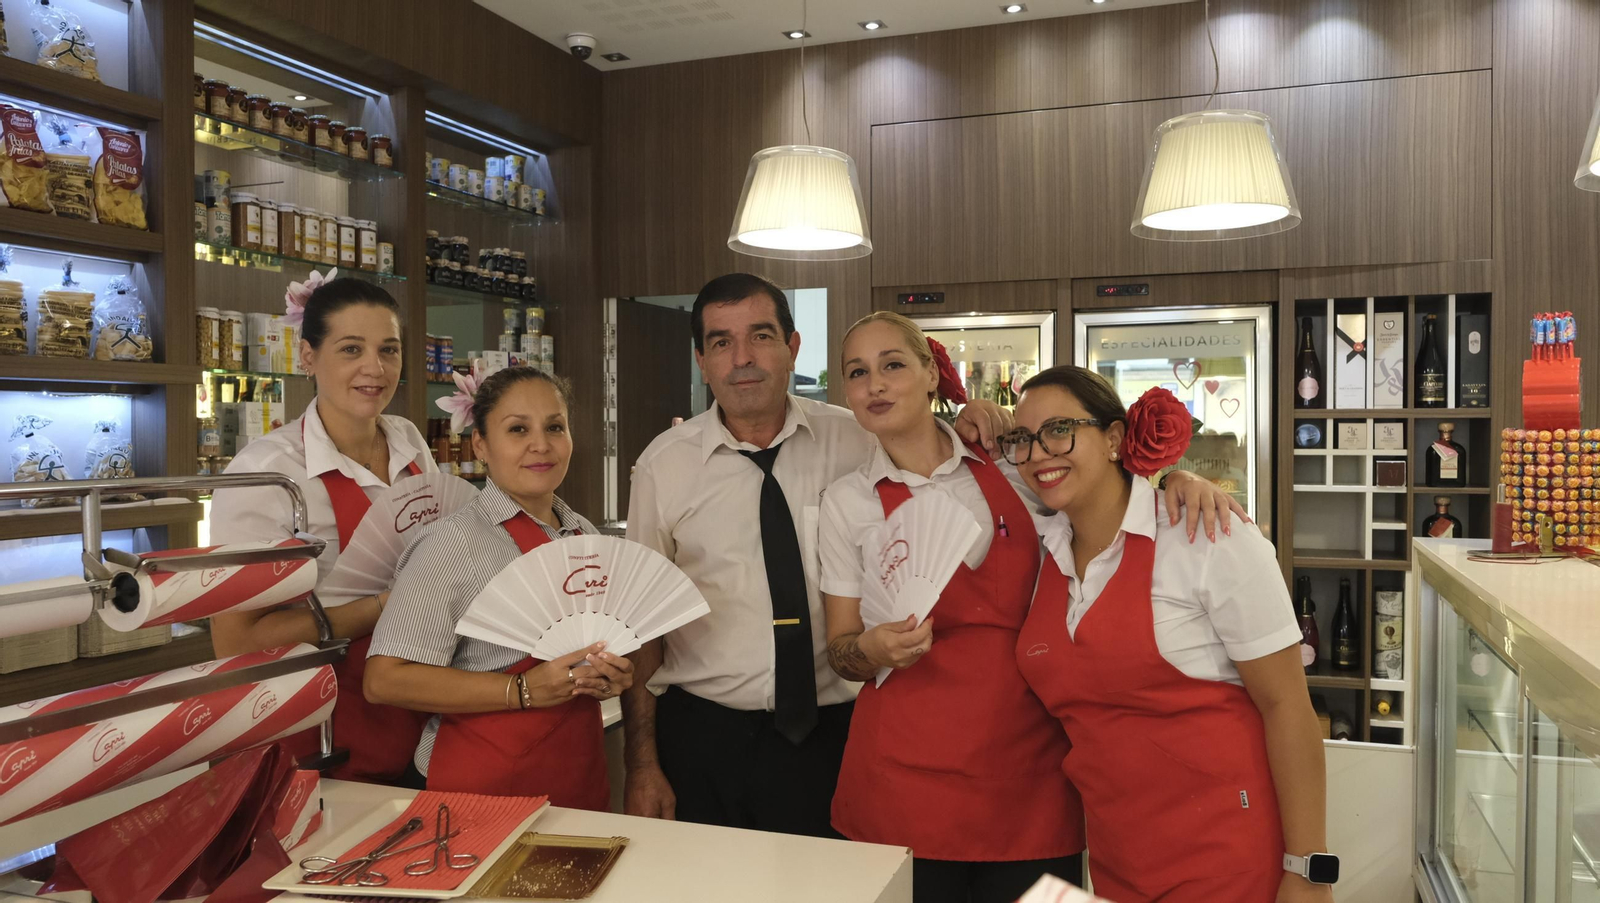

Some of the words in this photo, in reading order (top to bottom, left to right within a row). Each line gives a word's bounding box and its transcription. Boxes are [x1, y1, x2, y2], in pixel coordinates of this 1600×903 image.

[1101, 335, 1241, 349] ESPECIALIDADES
[394, 495, 439, 533] Capri
[1026, 643, 1049, 656] Capri
[183, 704, 211, 735] Capri
[252, 690, 277, 719] Capri
[93, 728, 125, 762] Capri
[0, 746, 37, 784] Capri
